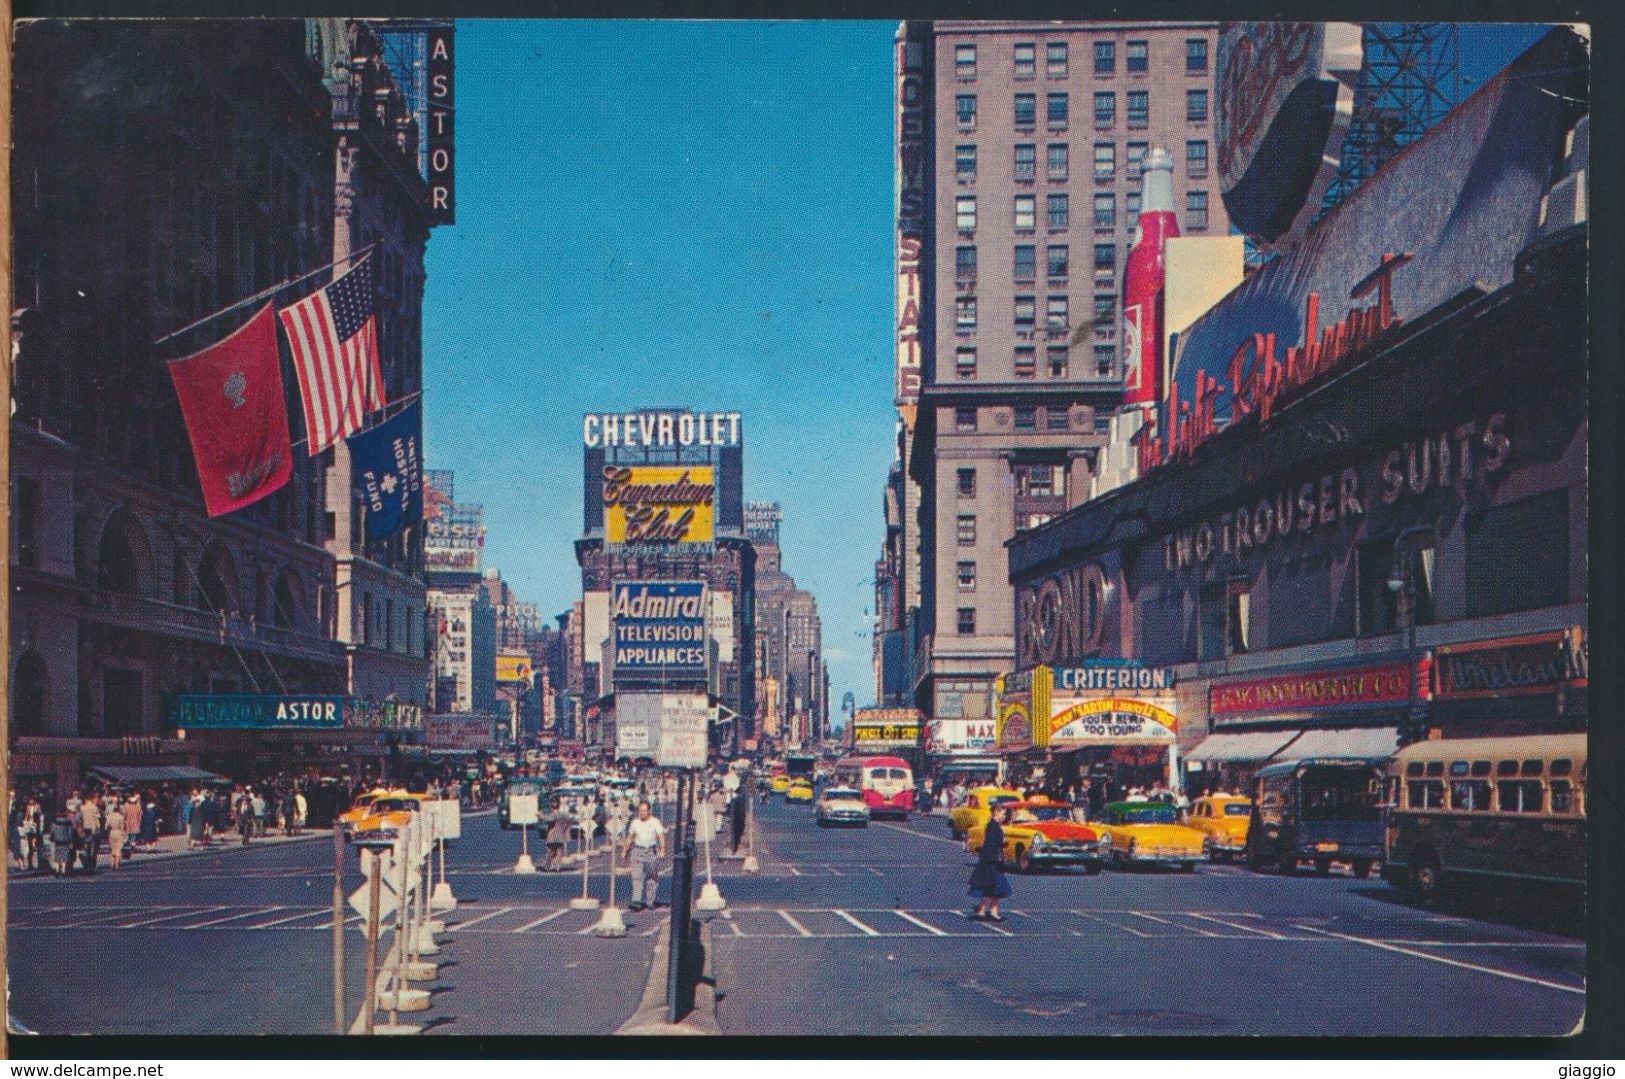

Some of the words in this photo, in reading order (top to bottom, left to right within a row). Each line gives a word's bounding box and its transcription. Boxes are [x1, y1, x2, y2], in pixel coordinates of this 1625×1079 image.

[432, 37, 449, 211] ASTOR
[900, 236, 923, 397] STATE
[583, 413, 742, 448] CHEVROLET
[363, 469, 383, 512] FUND
[602, 465, 715, 508] Canadian
[1216, 465, 1364, 557] TROUSER
[1380, 412, 1512, 507] SUITS
[624, 504, 695, 545] Club
[614, 583, 709, 621] Admiral
[1019, 563, 1106, 665] BOND
[617, 625, 704, 642] TELEVISION
[616, 648, 704, 664] APPLIANCES
[1062, 667, 1166, 689] CRITERION
[276, 701, 337, 721] ASTOR
[1084, 724, 1105, 736] TOO
[1107, 724, 1144, 737] YOUNG
